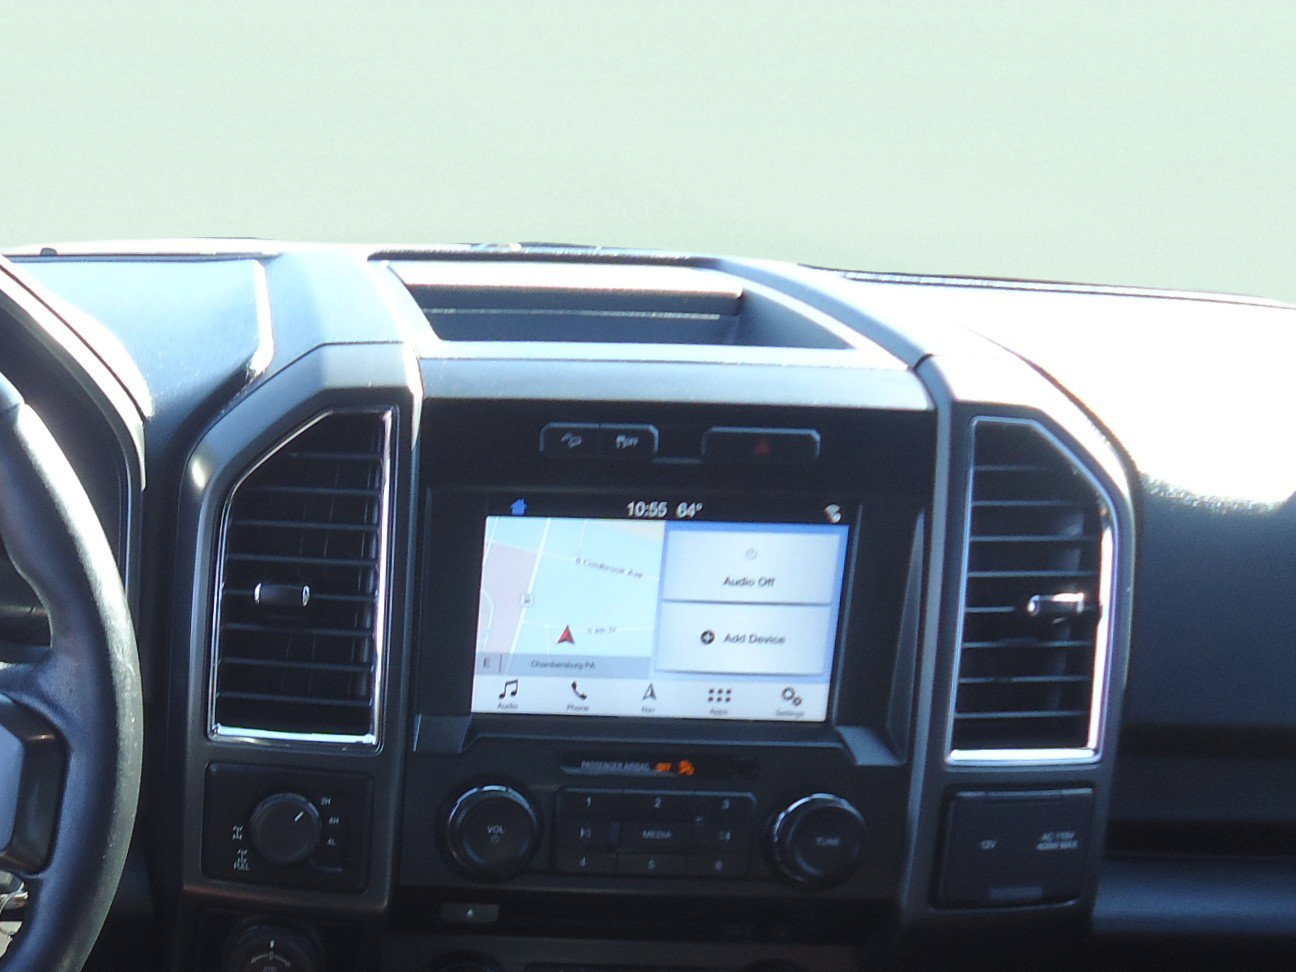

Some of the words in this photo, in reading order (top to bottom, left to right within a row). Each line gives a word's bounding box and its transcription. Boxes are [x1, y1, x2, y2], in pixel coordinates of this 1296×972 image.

[625, 500, 668, 518] 10:55
[722, 576, 755, 587] Audio
[757, 576, 777, 587] Off
[723, 633, 746, 643] Add
[749, 634, 786, 644] Device
